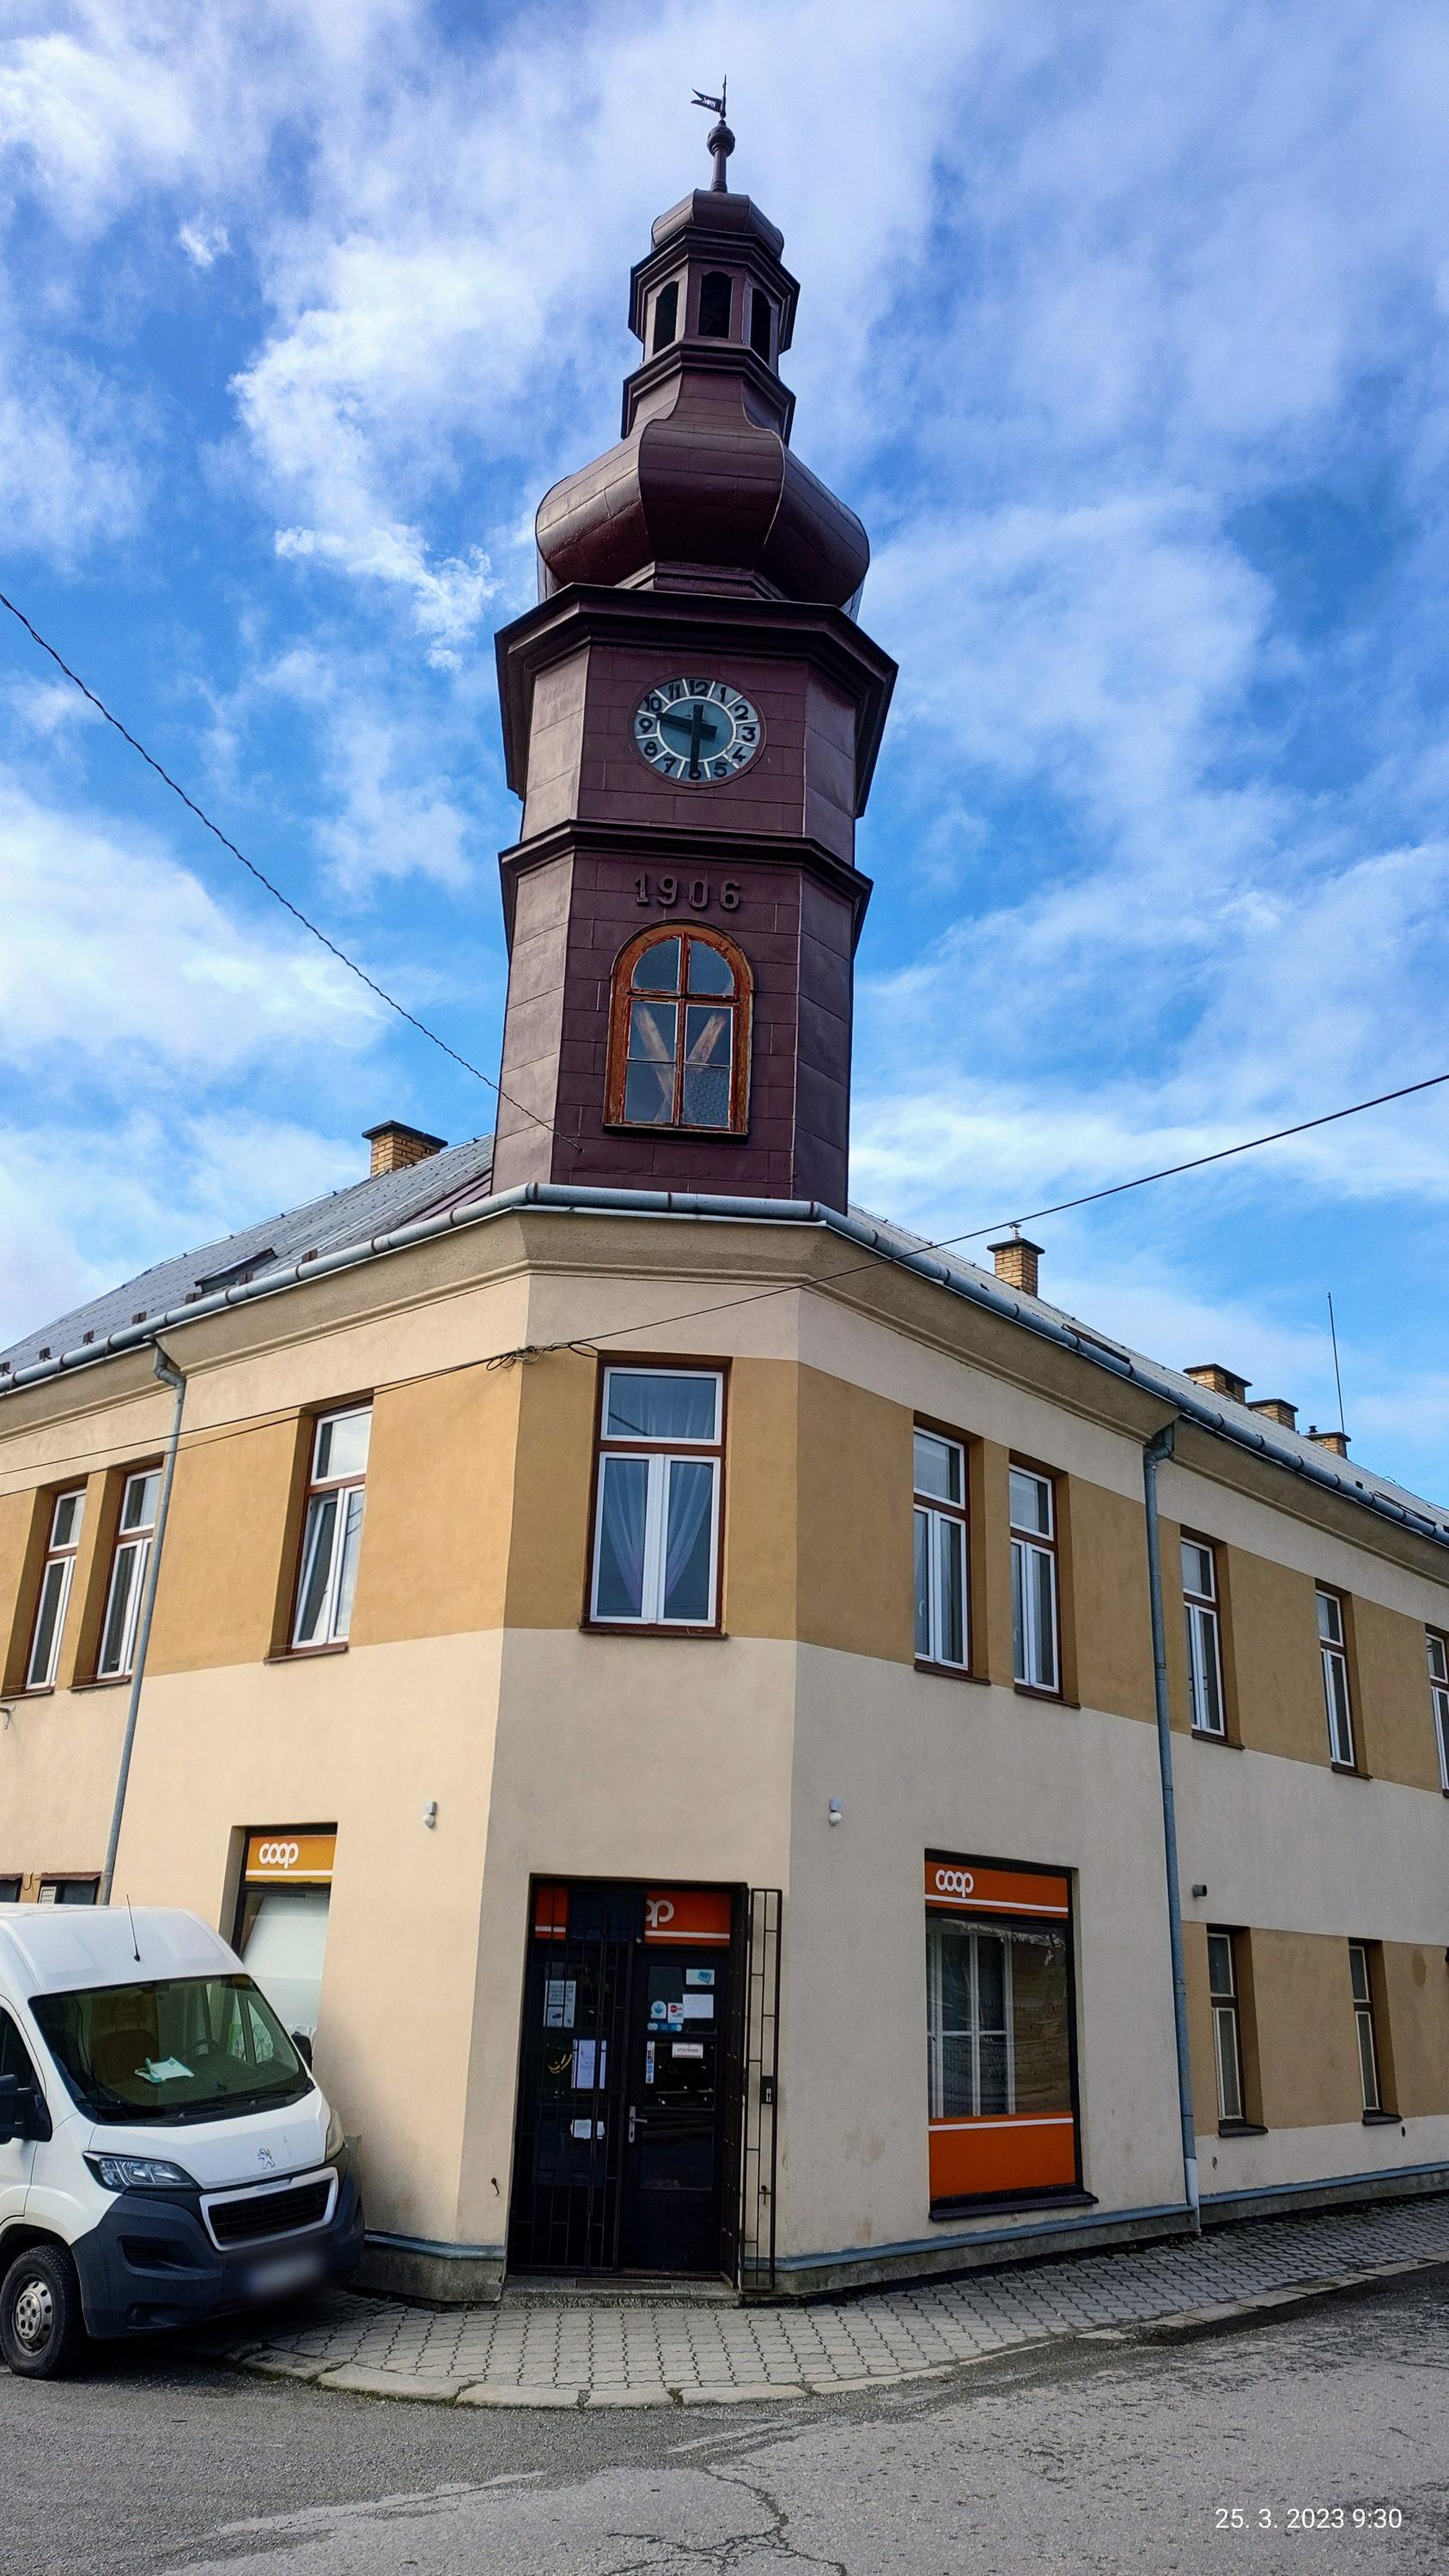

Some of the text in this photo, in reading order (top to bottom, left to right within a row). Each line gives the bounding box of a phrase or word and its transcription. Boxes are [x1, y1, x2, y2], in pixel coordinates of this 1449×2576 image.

[668, 683, 680, 699] 11
[689, 679, 709, 696] 12
[720, 687, 727, 702] 1
[645, 696, 662, 712] 10
[734, 705, 749, 720] 2
[639, 717, 653, 733] 9
[741, 726, 756, 742] 3
[644, 741, 658, 756] 8
[732, 746, 746, 762] 4
[664, 757, 677, 773] 7
[714, 762, 728, 777] 5
[635, 872, 741, 911] 1906
[259, 1842, 299, 1869] coop
[935, 1869, 974, 1898] coop
